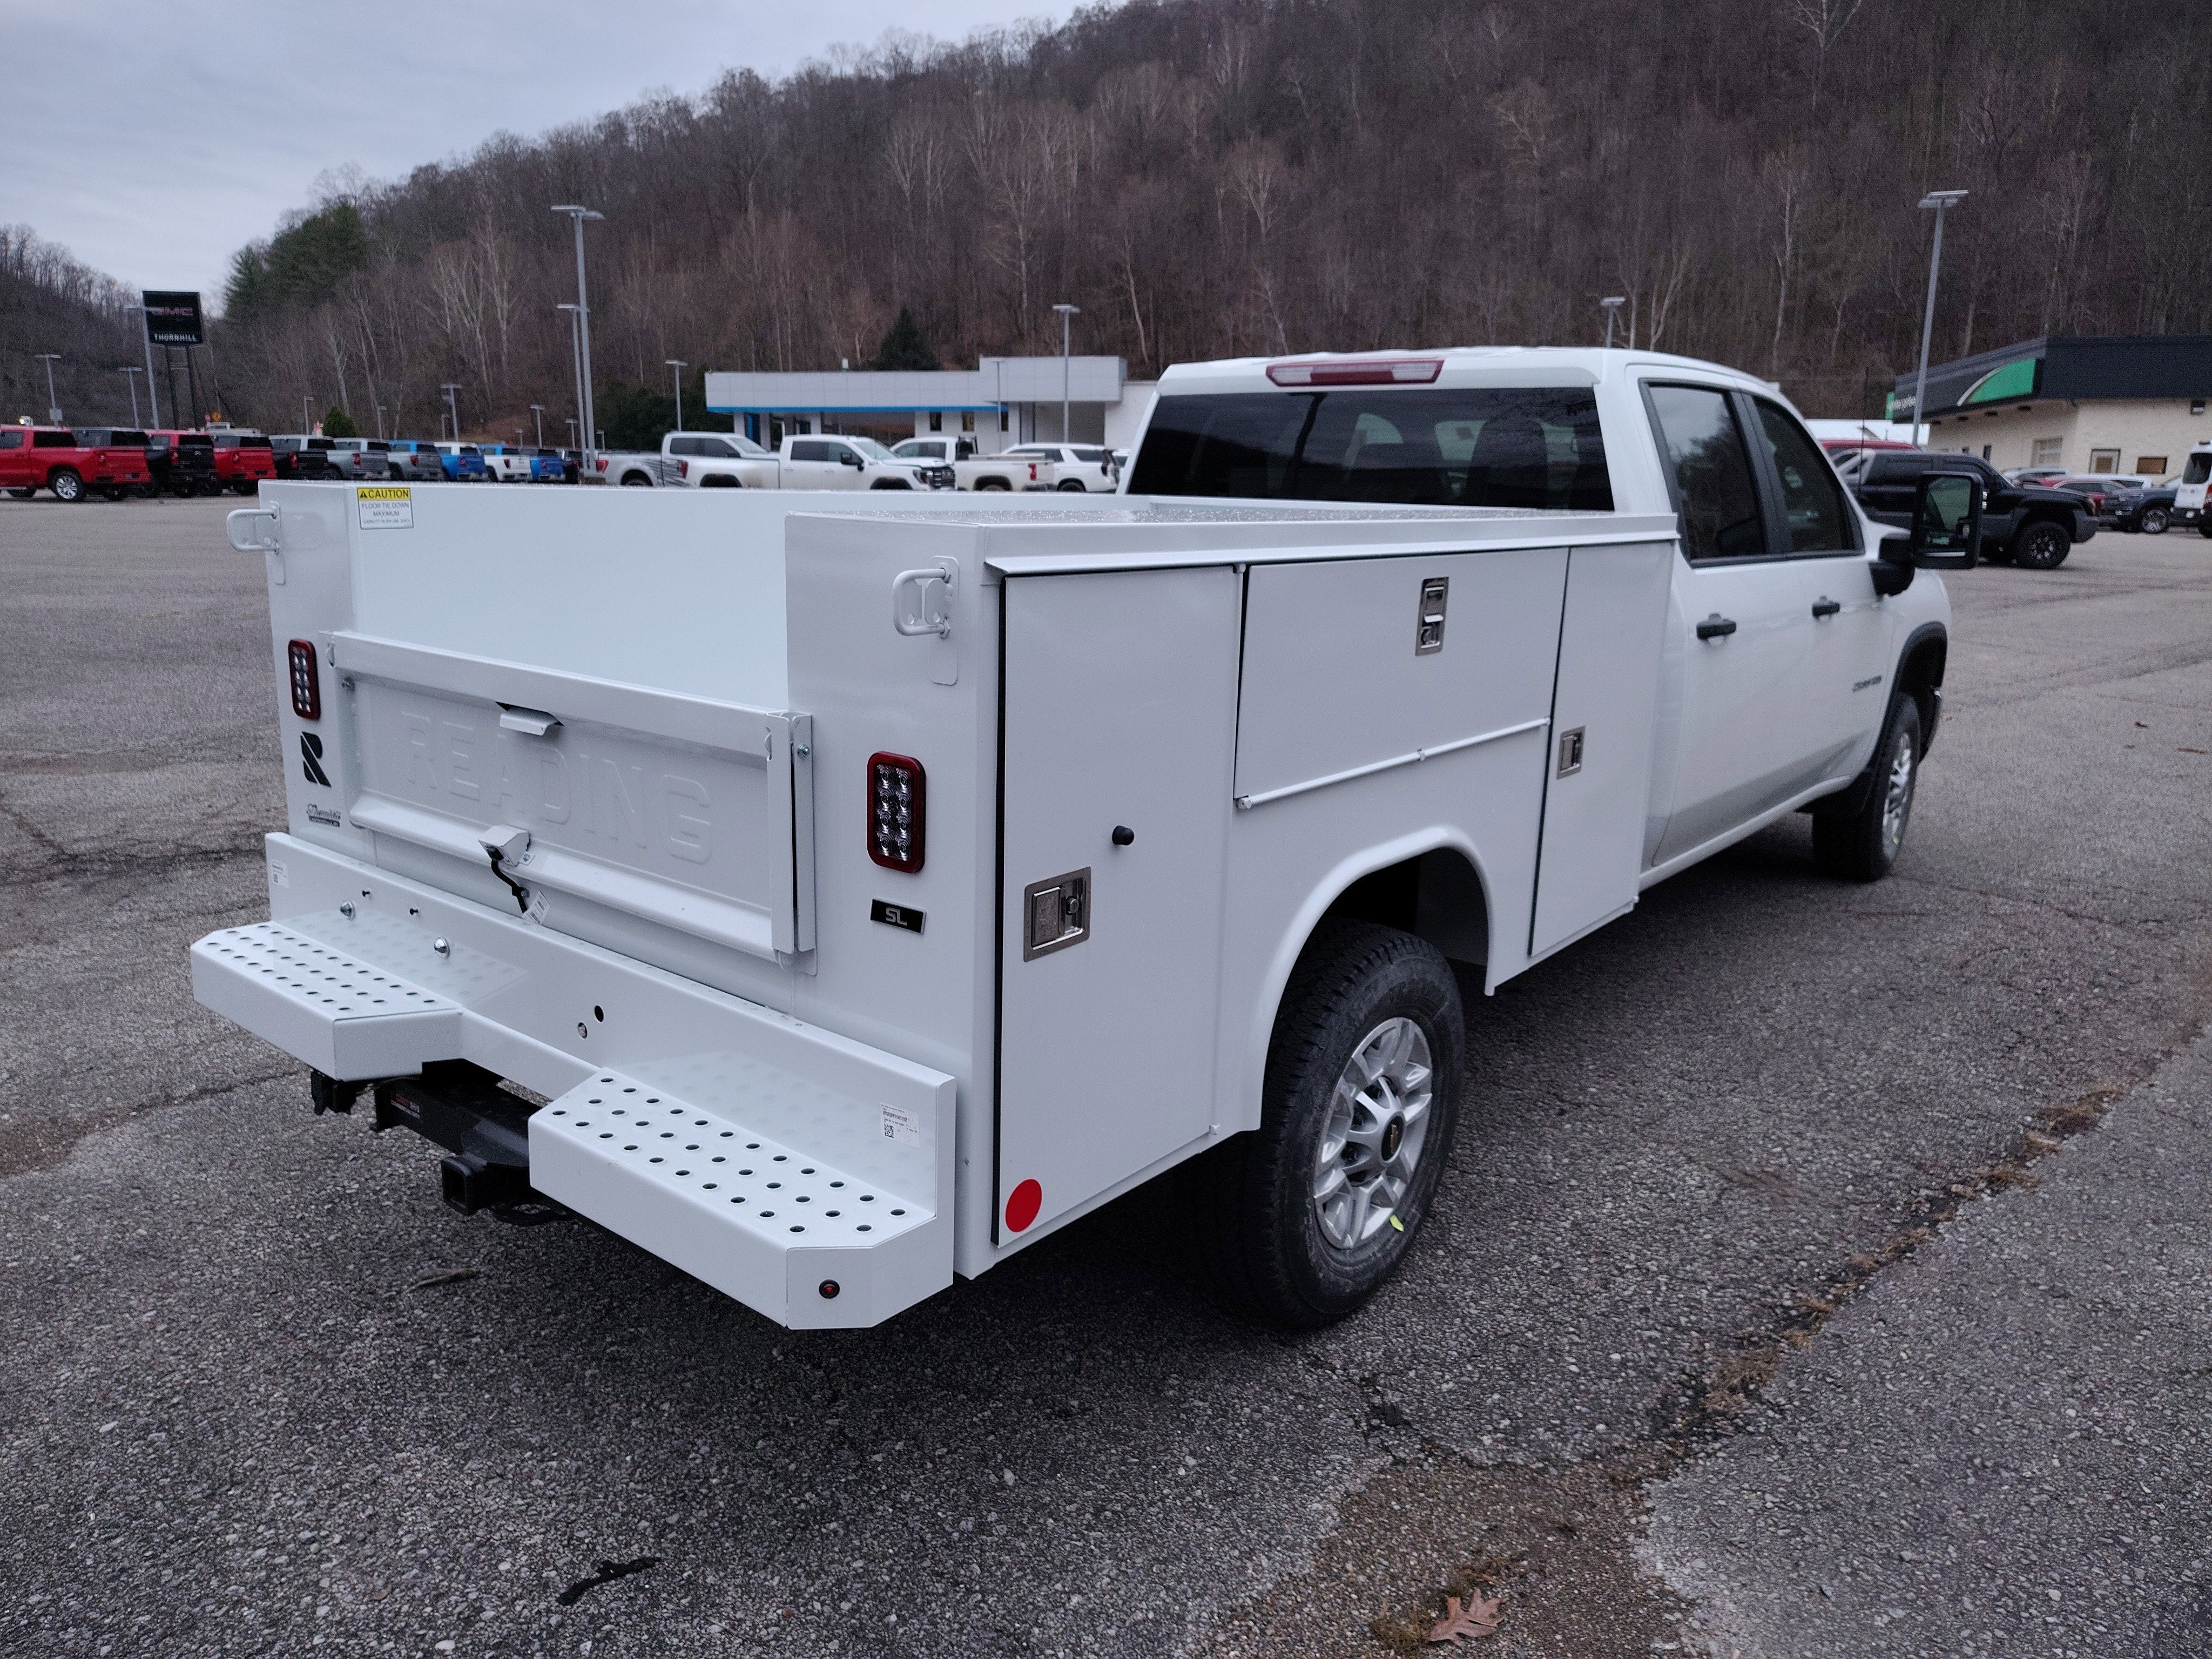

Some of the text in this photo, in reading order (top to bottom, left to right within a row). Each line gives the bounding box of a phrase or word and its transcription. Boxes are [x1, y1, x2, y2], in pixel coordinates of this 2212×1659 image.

[154, 333, 197, 342] THORNHILL
[368, 490, 409, 499] CAUTION
[400, 711, 713, 865] READING
[886, 906, 907, 926] SL
